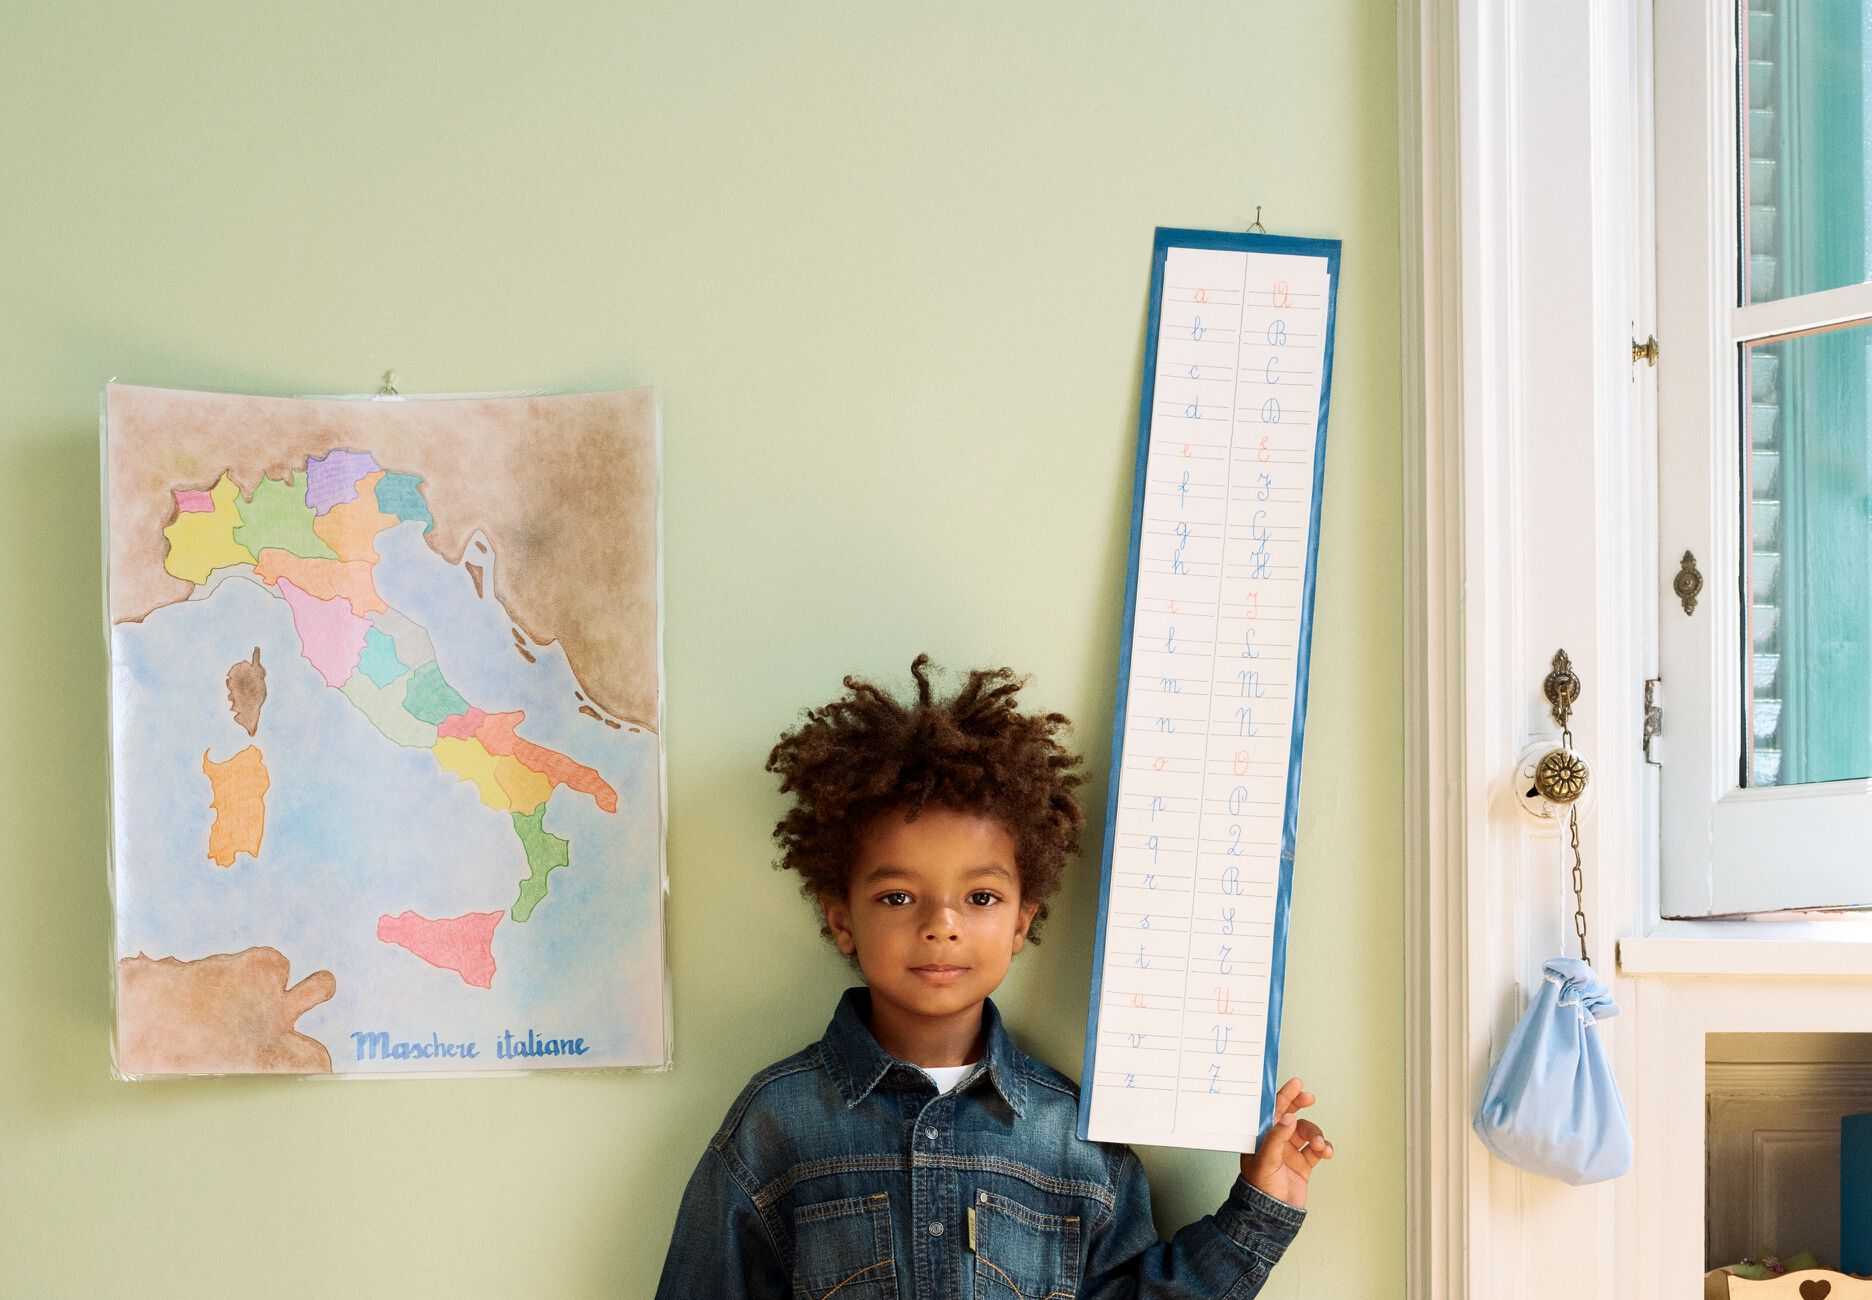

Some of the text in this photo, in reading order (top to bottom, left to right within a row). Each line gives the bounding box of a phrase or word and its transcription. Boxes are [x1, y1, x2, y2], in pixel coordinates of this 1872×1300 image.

[1193, 288, 1209, 303] a
[1191, 315, 1286, 345] b B
[1188, 356, 1280, 384] c C
[1184, 396, 1280, 423] d D
[1183, 443, 1192, 457] e
[1178, 470, 1189, 508] f
[1173, 510, 1272, 554] g G
[1172, 548, 1272, 579] h H
[1241, 628, 1259, 659] L
[1160, 670, 1265, 698] m M
[1156, 707, 1258, 737] n N
[1153, 756, 1168, 771] o
[1149, 785, 1248, 822] p P
[1145, 835, 1158, 864] q
[1221, 866, 1244, 895] R
[1139, 914, 1151, 929] s
[1134, 944, 1151, 969] t
[1131, 986, 1234, 1015] u U
[351, 1029, 590, 1061] Maschere italiane
[1128, 1024, 1233, 1054] v V
[1124, 1072, 1136, 1088] z
